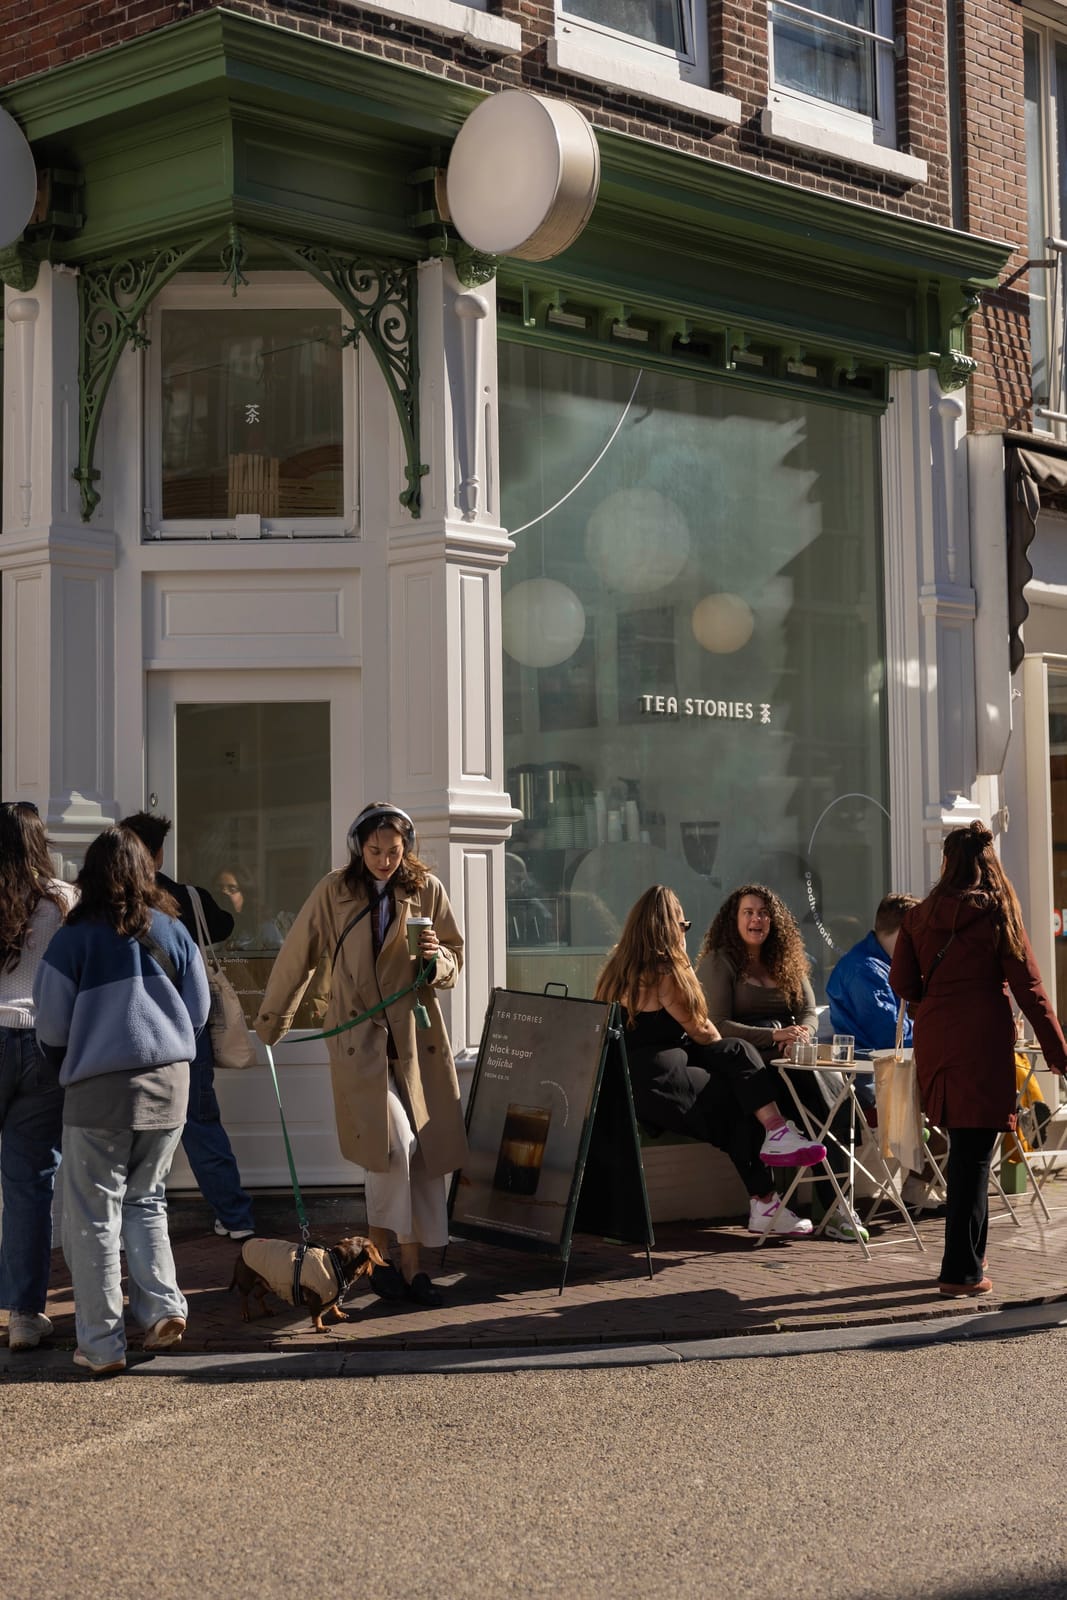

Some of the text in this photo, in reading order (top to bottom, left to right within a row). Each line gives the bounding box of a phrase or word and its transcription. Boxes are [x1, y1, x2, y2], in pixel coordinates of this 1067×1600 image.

[245, 404, 260, 424] 茶
[642, 694, 754, 719] TEA STORIES
[496, 1011, 543, 1024] TEA STORIES
[490, 1043, 533, 1058] black sugar
[487, 1056, 513, 1069] hojicha
